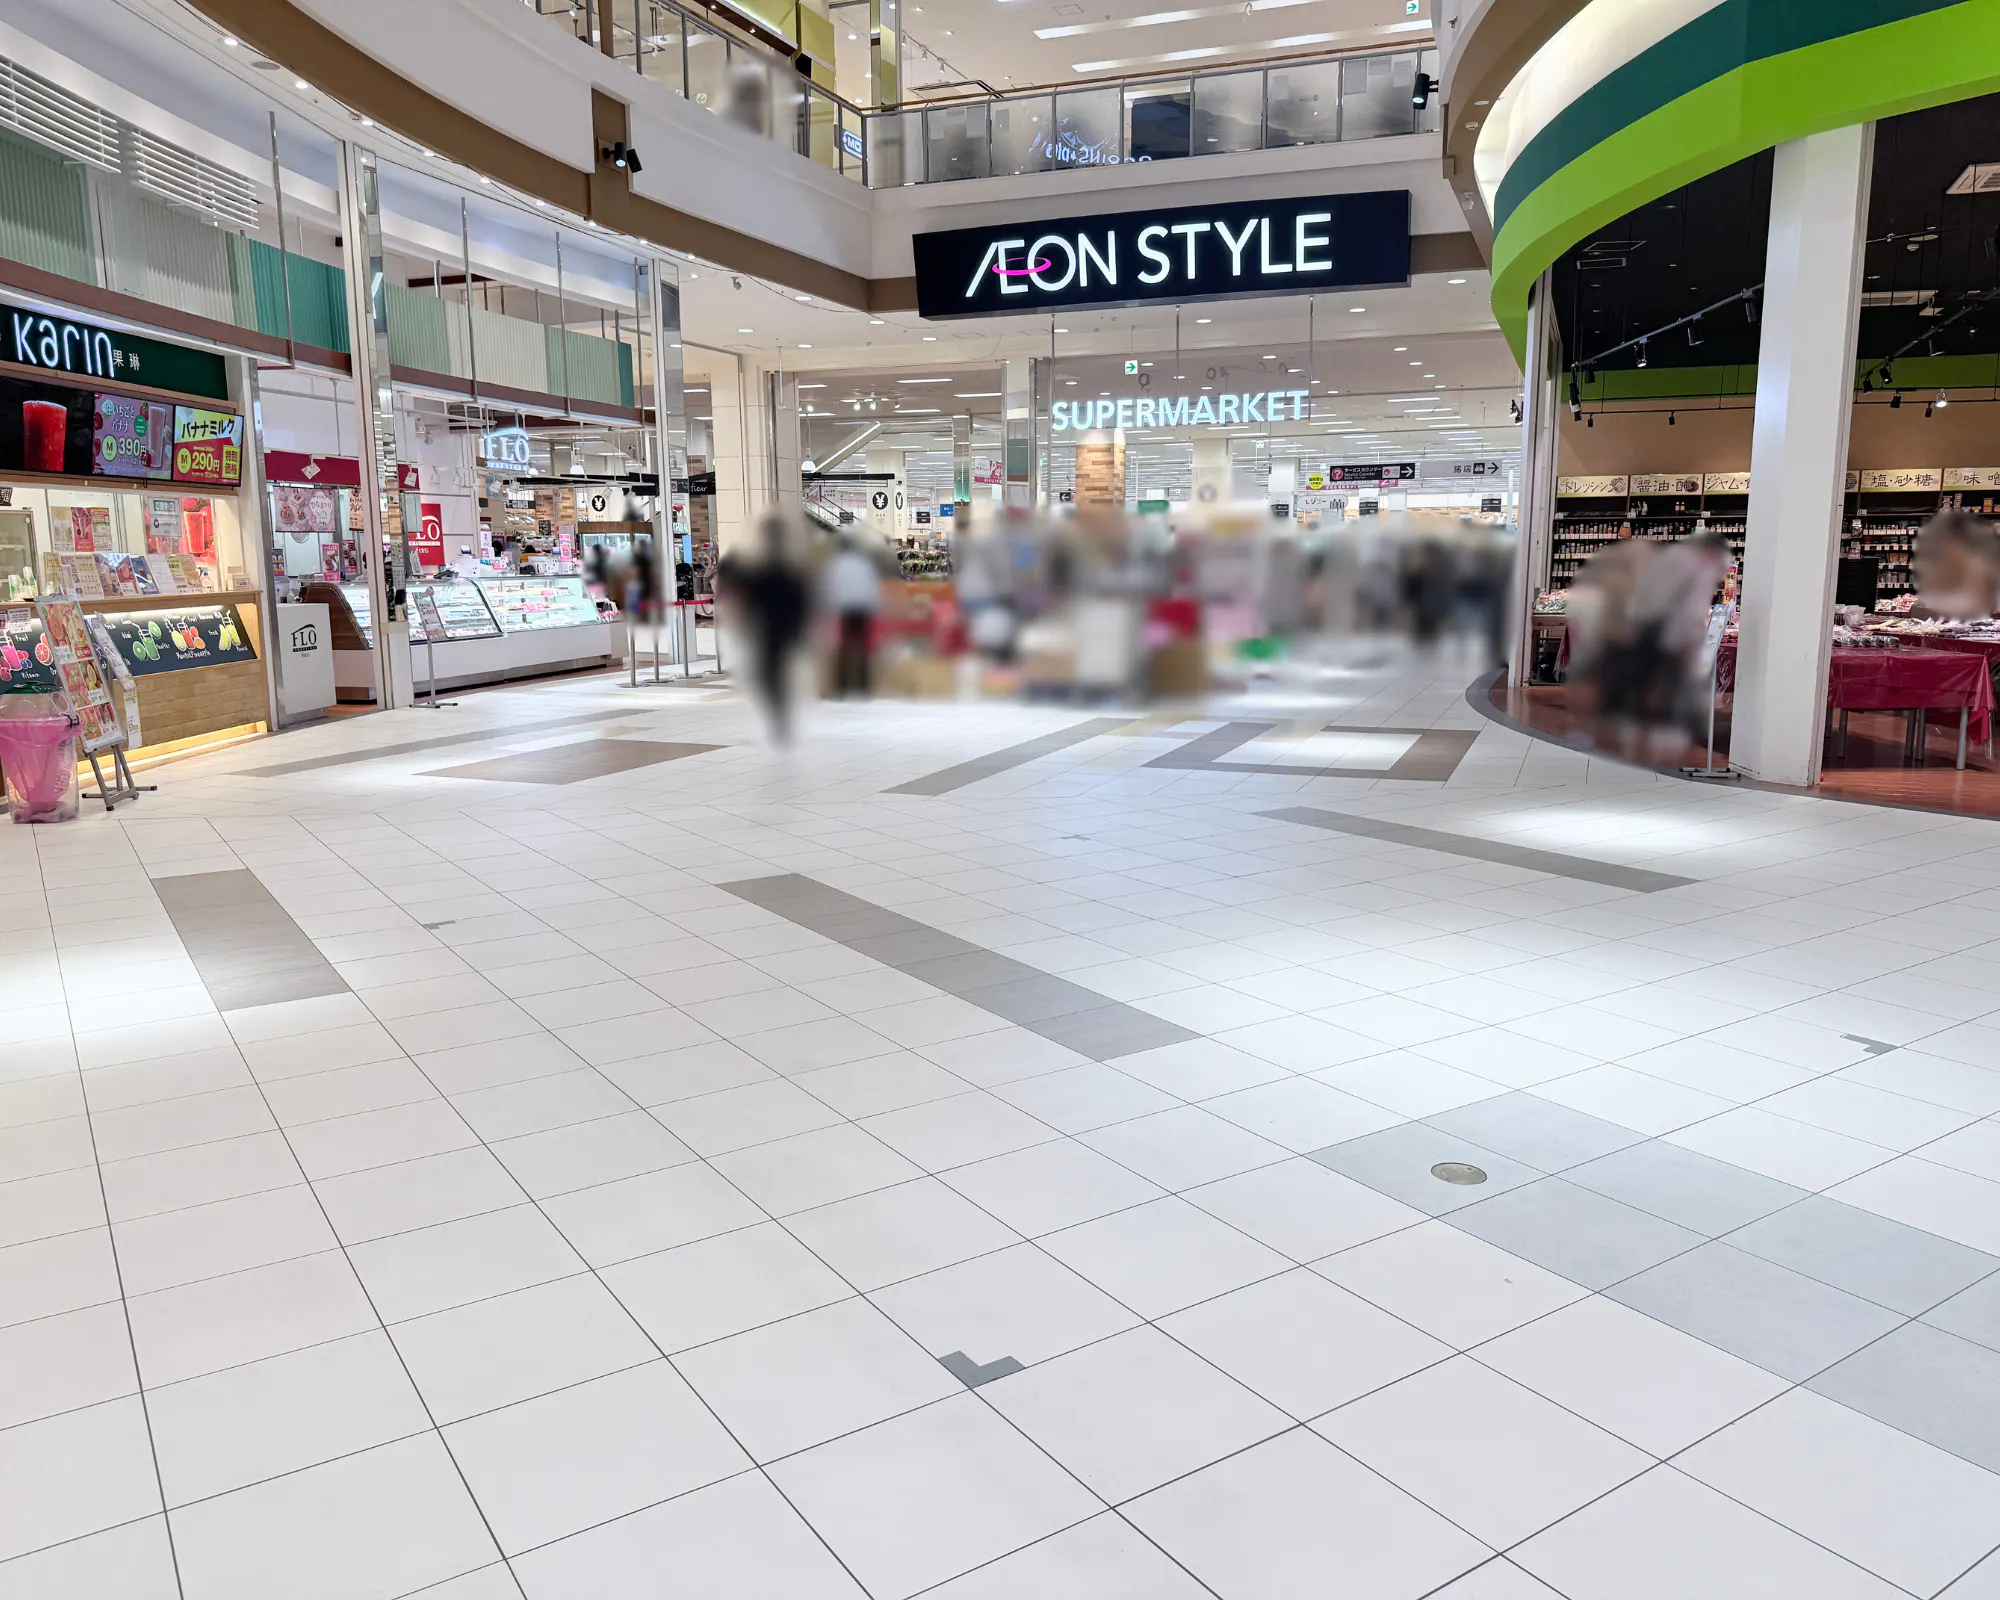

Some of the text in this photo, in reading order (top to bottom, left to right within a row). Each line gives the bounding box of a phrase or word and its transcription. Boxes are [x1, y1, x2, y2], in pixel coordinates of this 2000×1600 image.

[1137, 212, 1333, 284] STYLE
[1051, 390, 1310, 431] SUPERMARKET
[182, 418, 235, 438] バナナミルク
[1871, 473, 1934, 487] 塩・砂糖
[291, 625, 317, 647] FLO
